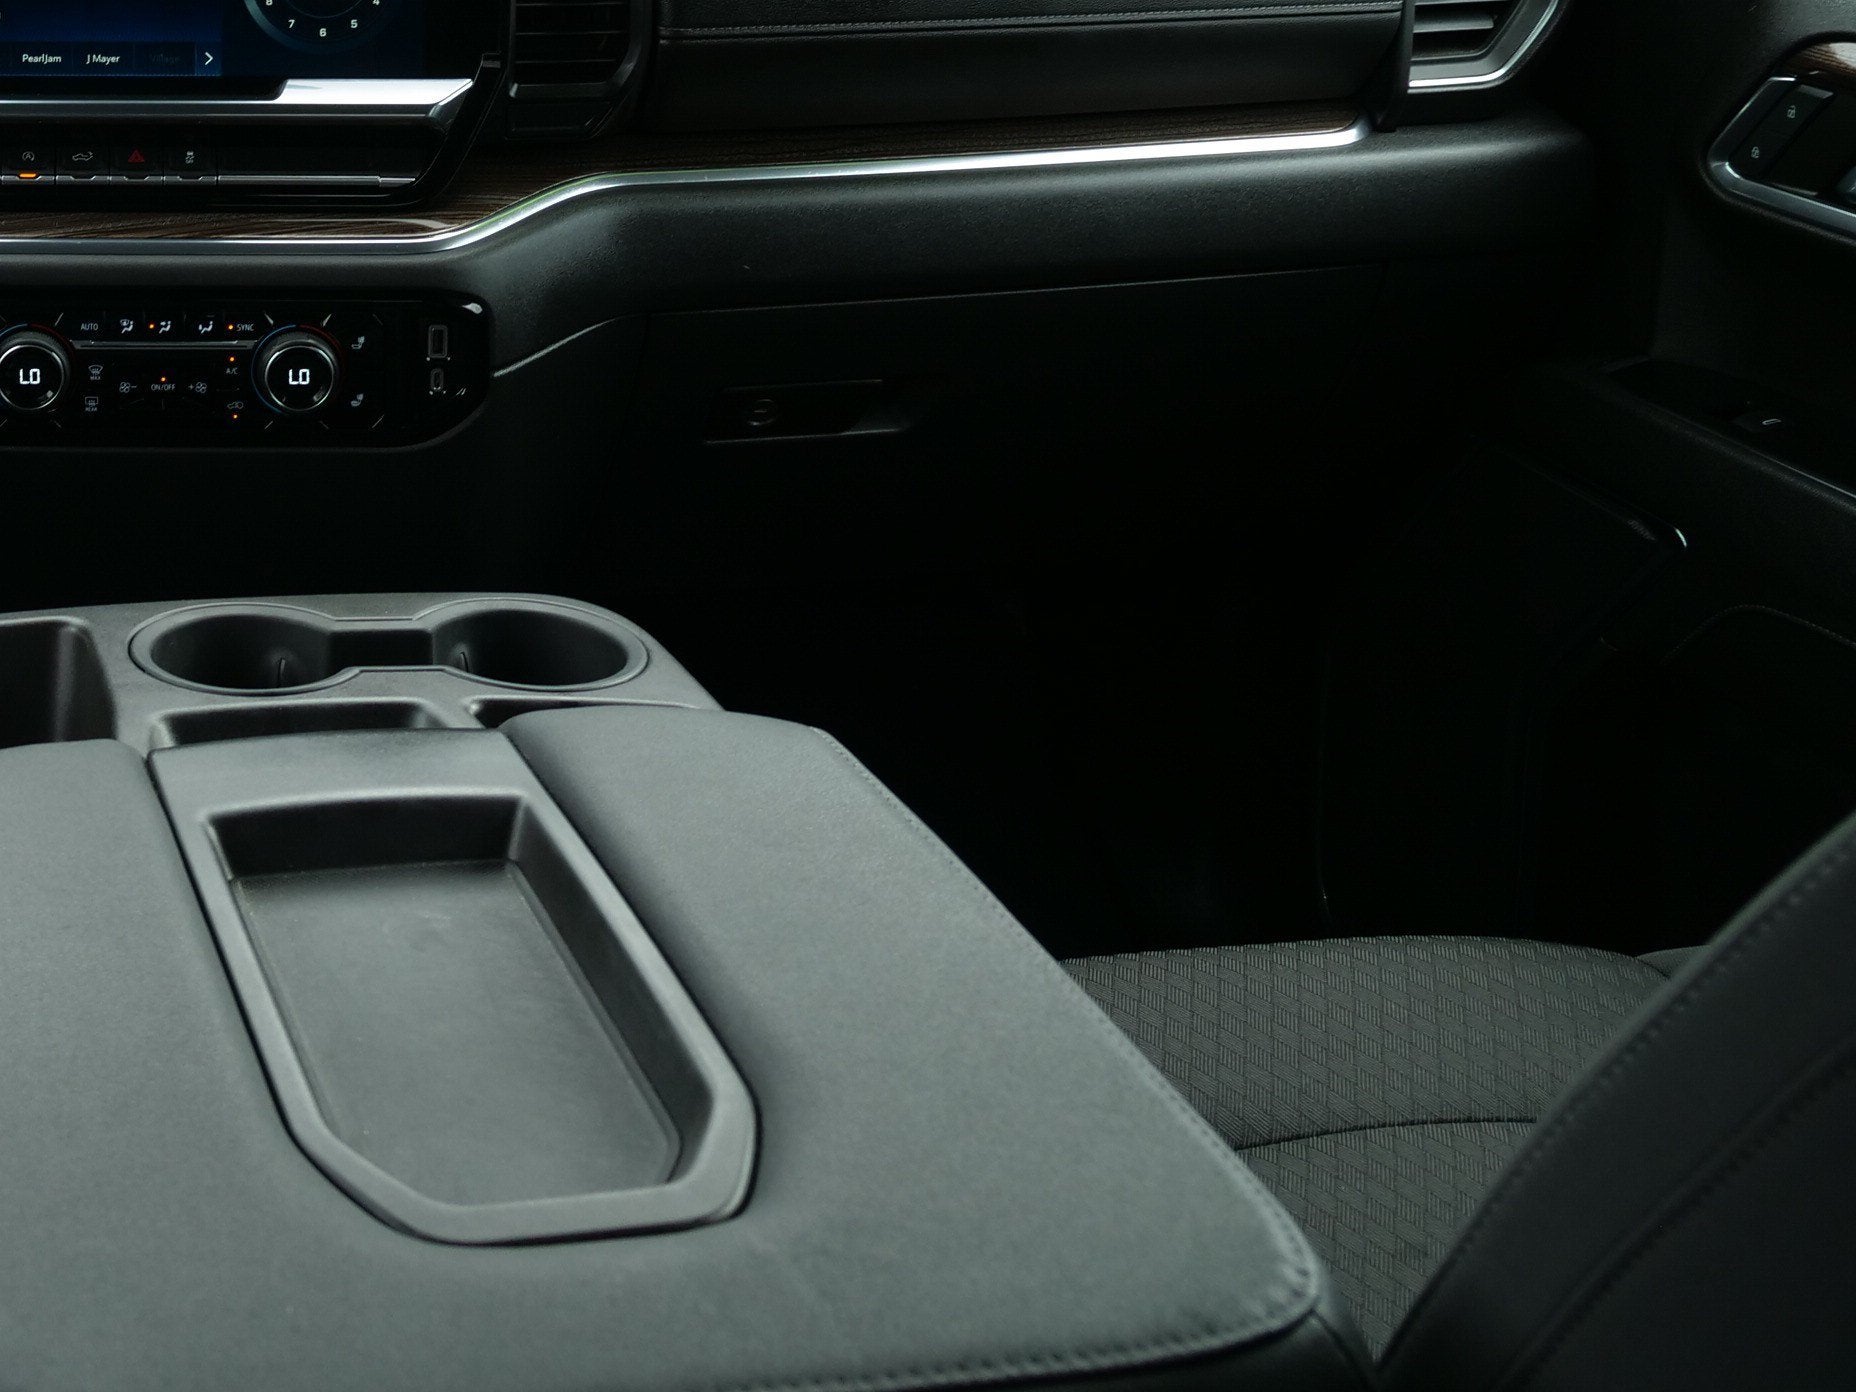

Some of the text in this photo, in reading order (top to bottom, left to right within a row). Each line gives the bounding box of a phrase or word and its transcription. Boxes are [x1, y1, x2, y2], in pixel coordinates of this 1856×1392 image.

[288, 20, 295, 28] 7
[351, 20, 358, 28] 5
[319, 28, 327, 37] 6
[92, 54, 120, 65] Mayer
[80, 324, 98, 332] AUTO
[237, 322, 254, 332] SYNC
[20, 372, 40, 387] LO
[288, 369, 310, 385] LO
